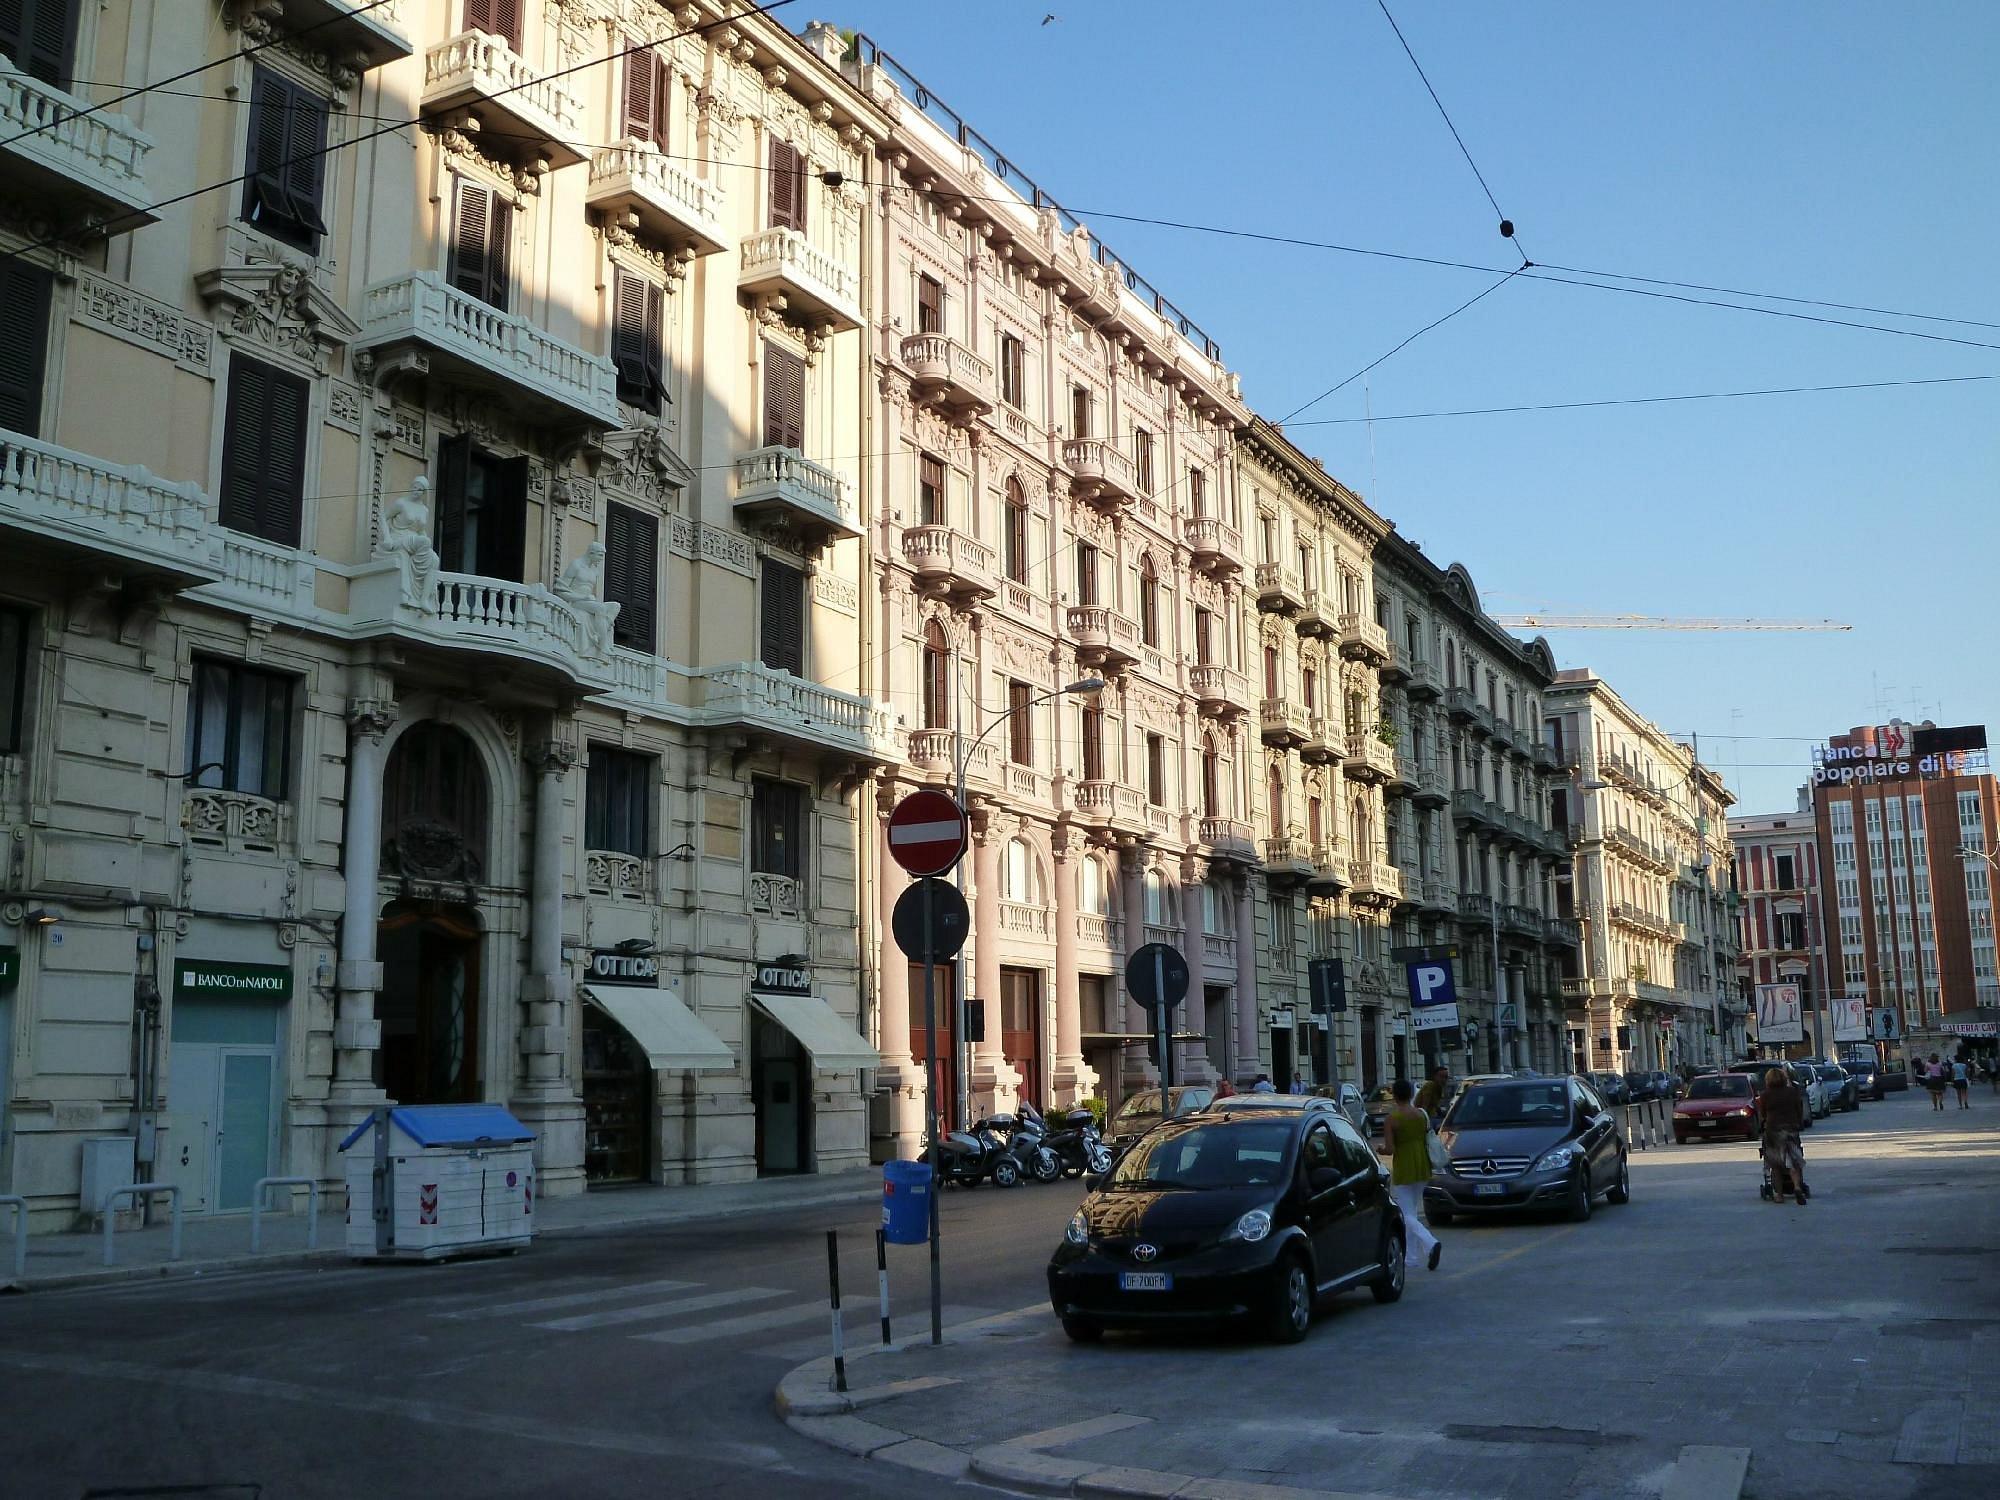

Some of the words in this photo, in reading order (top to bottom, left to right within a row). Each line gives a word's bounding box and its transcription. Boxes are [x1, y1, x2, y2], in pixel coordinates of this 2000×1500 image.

[1811, 744, 1877, 762] banca
[1812, 760, 1910, 787] popolare
[1919, 755, 1939, 772] di
[1945, 750, 1990, 771] bari
[595, 955, 655, 977] OTTICA
[198, 974, 236, 988] BANCO
[245, 977, 283, 990] NAPOLI
[761, 967, 809, 988] OTTICA
[1416, 966, 1446, 1001] P
[1942, 1023, 1979, 1032] GALLERIA
